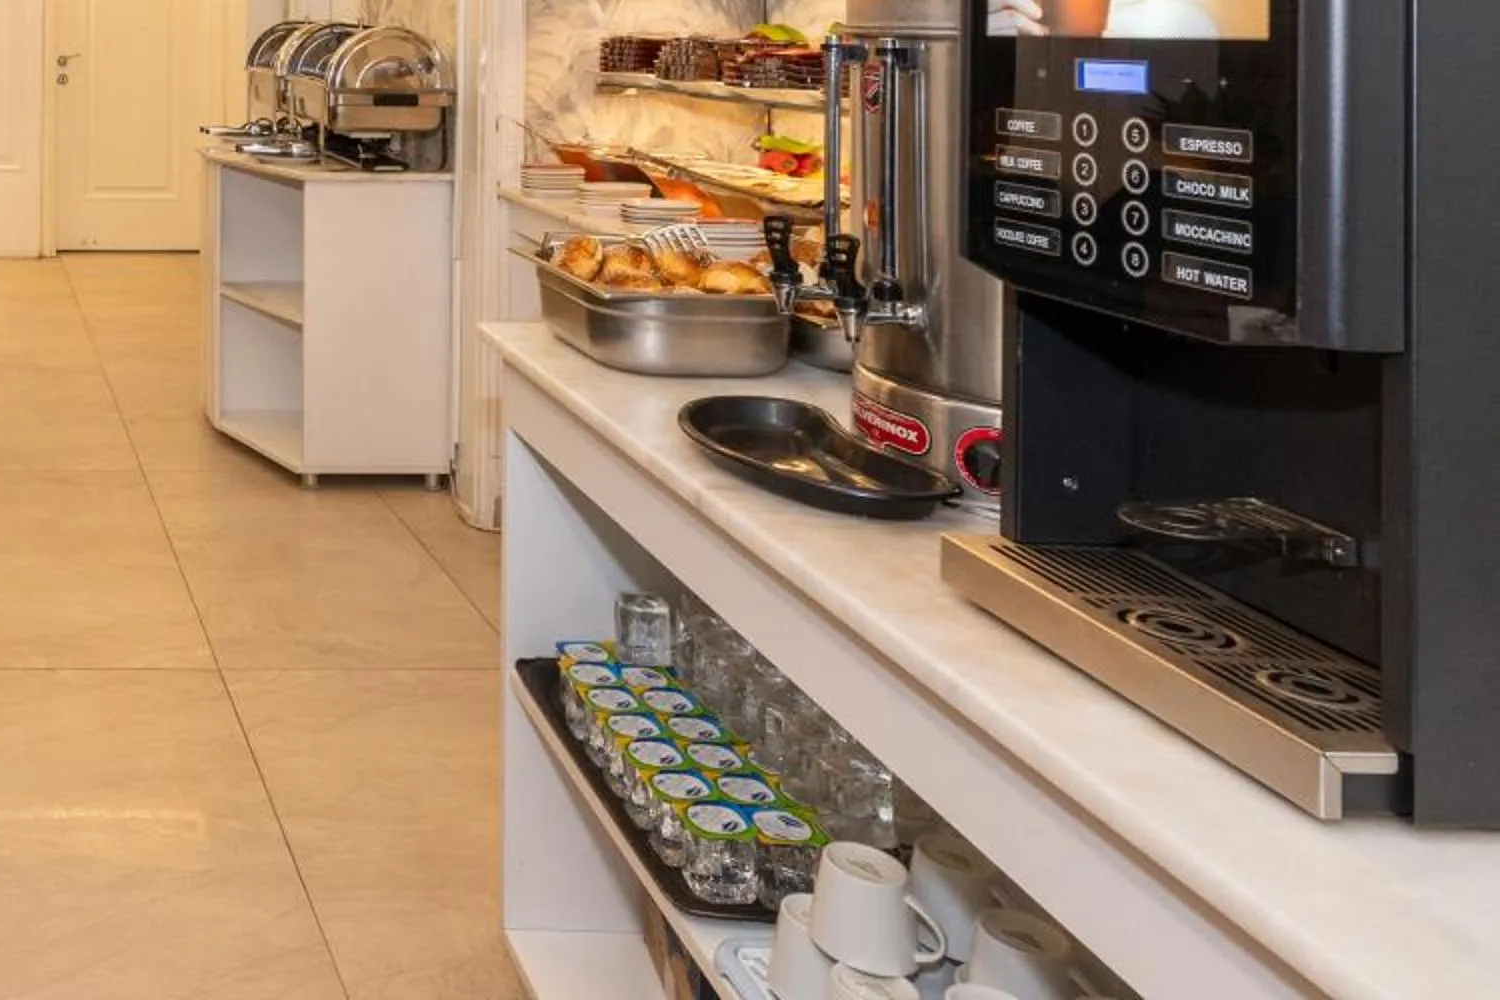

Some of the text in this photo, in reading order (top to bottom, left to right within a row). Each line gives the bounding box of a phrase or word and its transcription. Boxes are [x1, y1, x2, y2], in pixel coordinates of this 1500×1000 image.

[1007, 119, 1036, 133] COFFEE
[1080, 123, 1088, 137] 1
[1131, 128, 1141, 143] 5
[1179, 137, 1243, 155] ESPRESSO
[1016, 157, 1043, 171] COFFEE
[1080, 163, 1089, 177] 2
[1131, 169, 1141, 184] 6
[1176, 179, 1249, 202] CHOCO MILK
[1080, 202, 1089, 217] 3
[1131, 211, 1141, 226] 7
[1175, 223, 1252, 247] MOCCACHINO
[1079, 241, 1089, 255] 4
[1131, 253, 1140, 268] 8
[1176, 266, 1247, 293] HOT WATER
